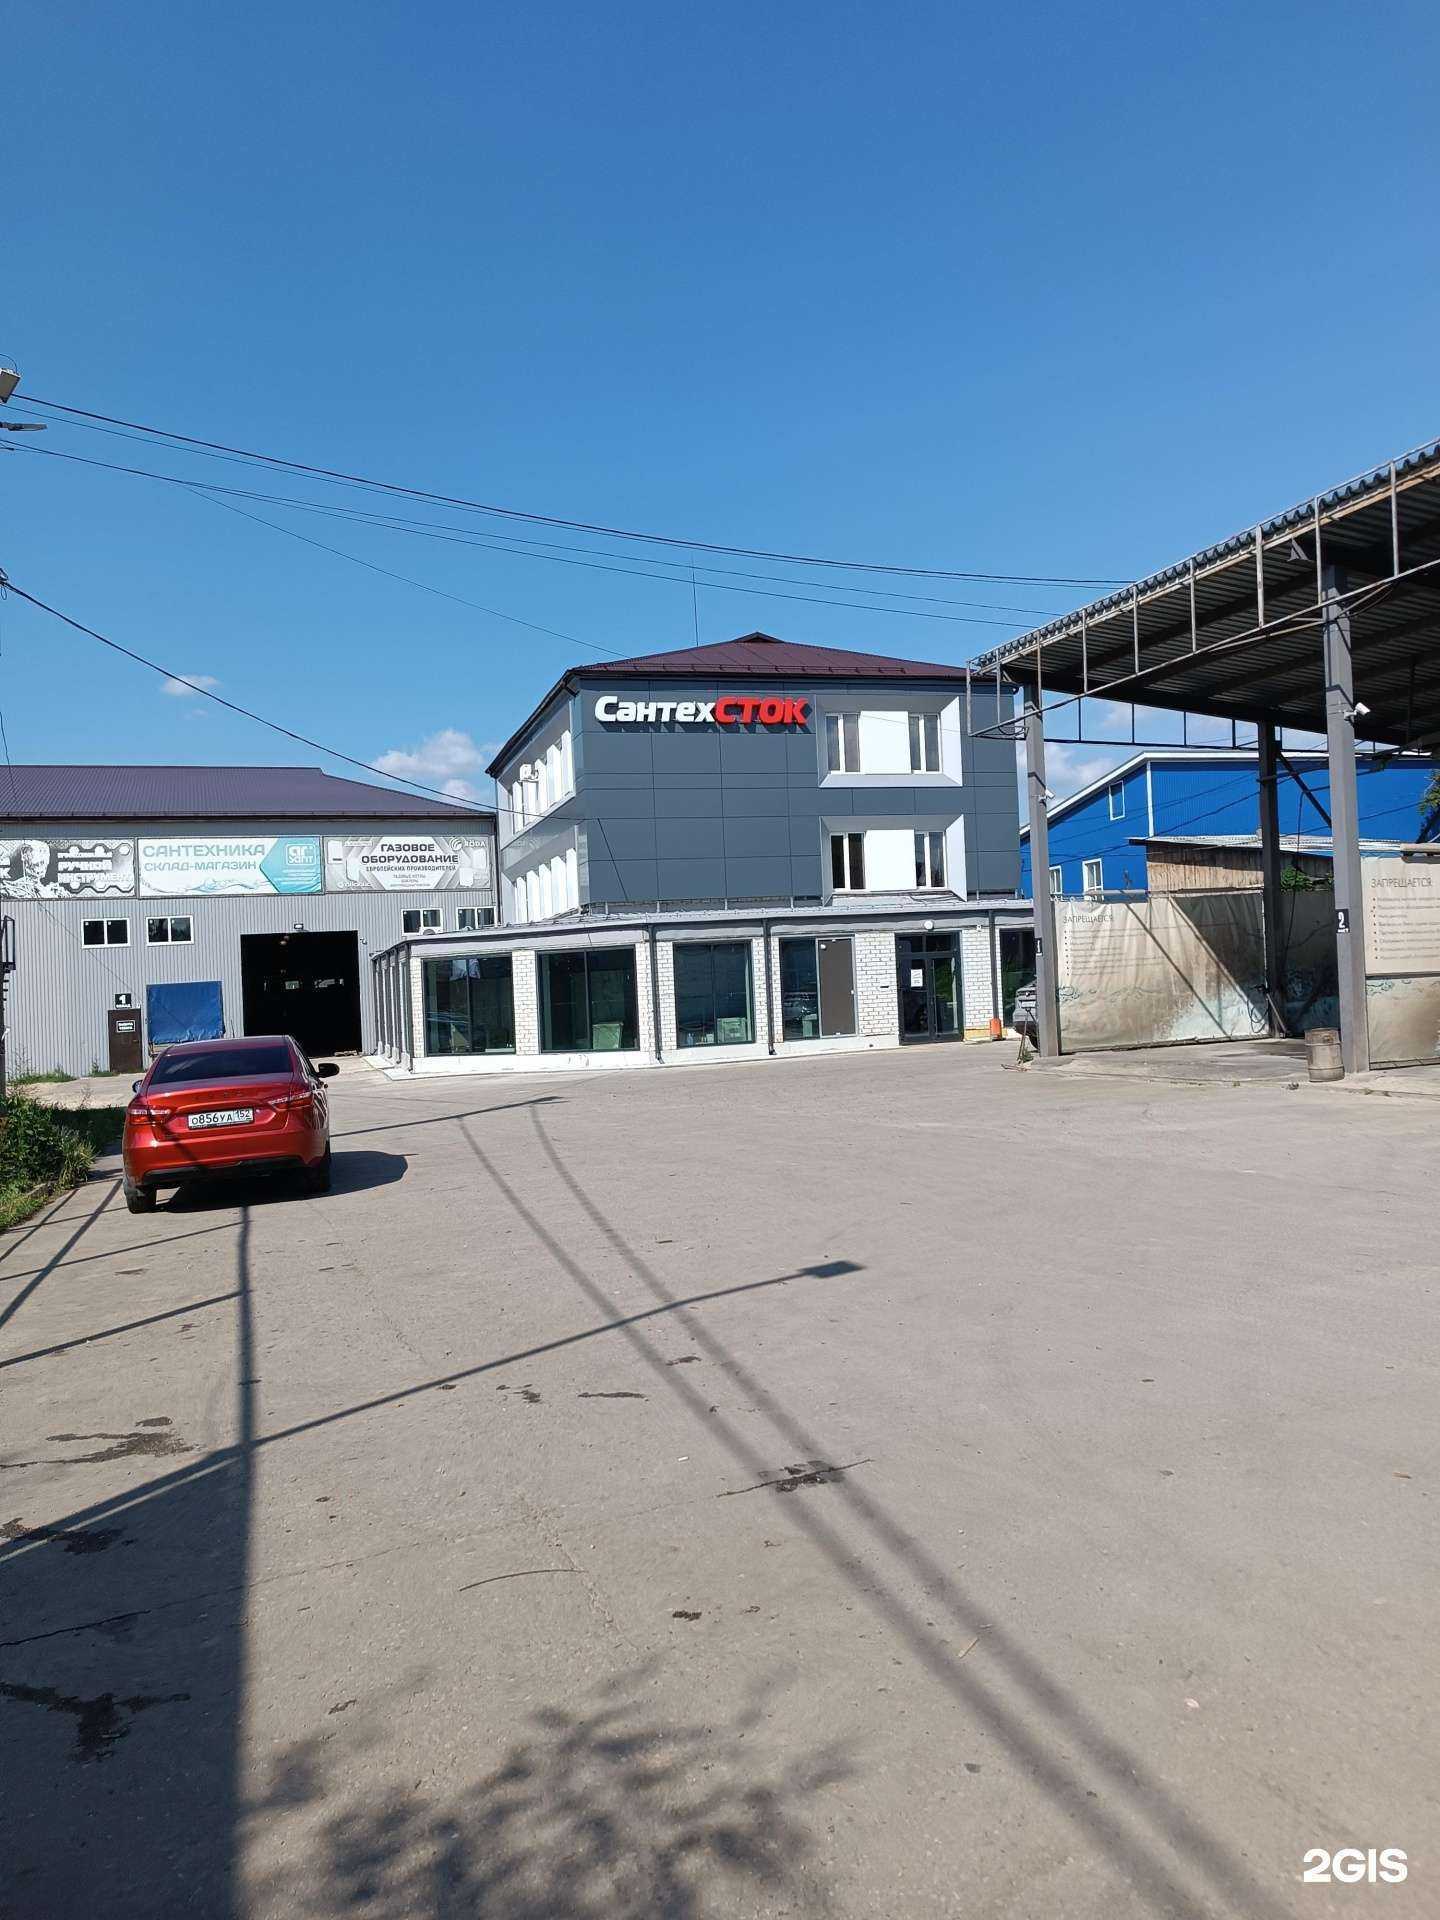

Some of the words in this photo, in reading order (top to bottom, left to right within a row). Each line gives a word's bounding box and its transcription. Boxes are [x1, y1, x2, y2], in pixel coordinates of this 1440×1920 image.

[143, 844, 265, 858] САНТЕХНИКА
[380, 843, 435, 852] ГАЗОВОЕ
[361, 855, 459, 864] ОБОРУДОВАНИЕ
[144, 860, 257, 872] СКЛАД-МАГАЗИН
[1371, 877, 1432, 888] ЗАПРЕЩАЕТСЯ
[1337, 911, 1346, 928] 2
[119, 994, 126, 1004] 1
